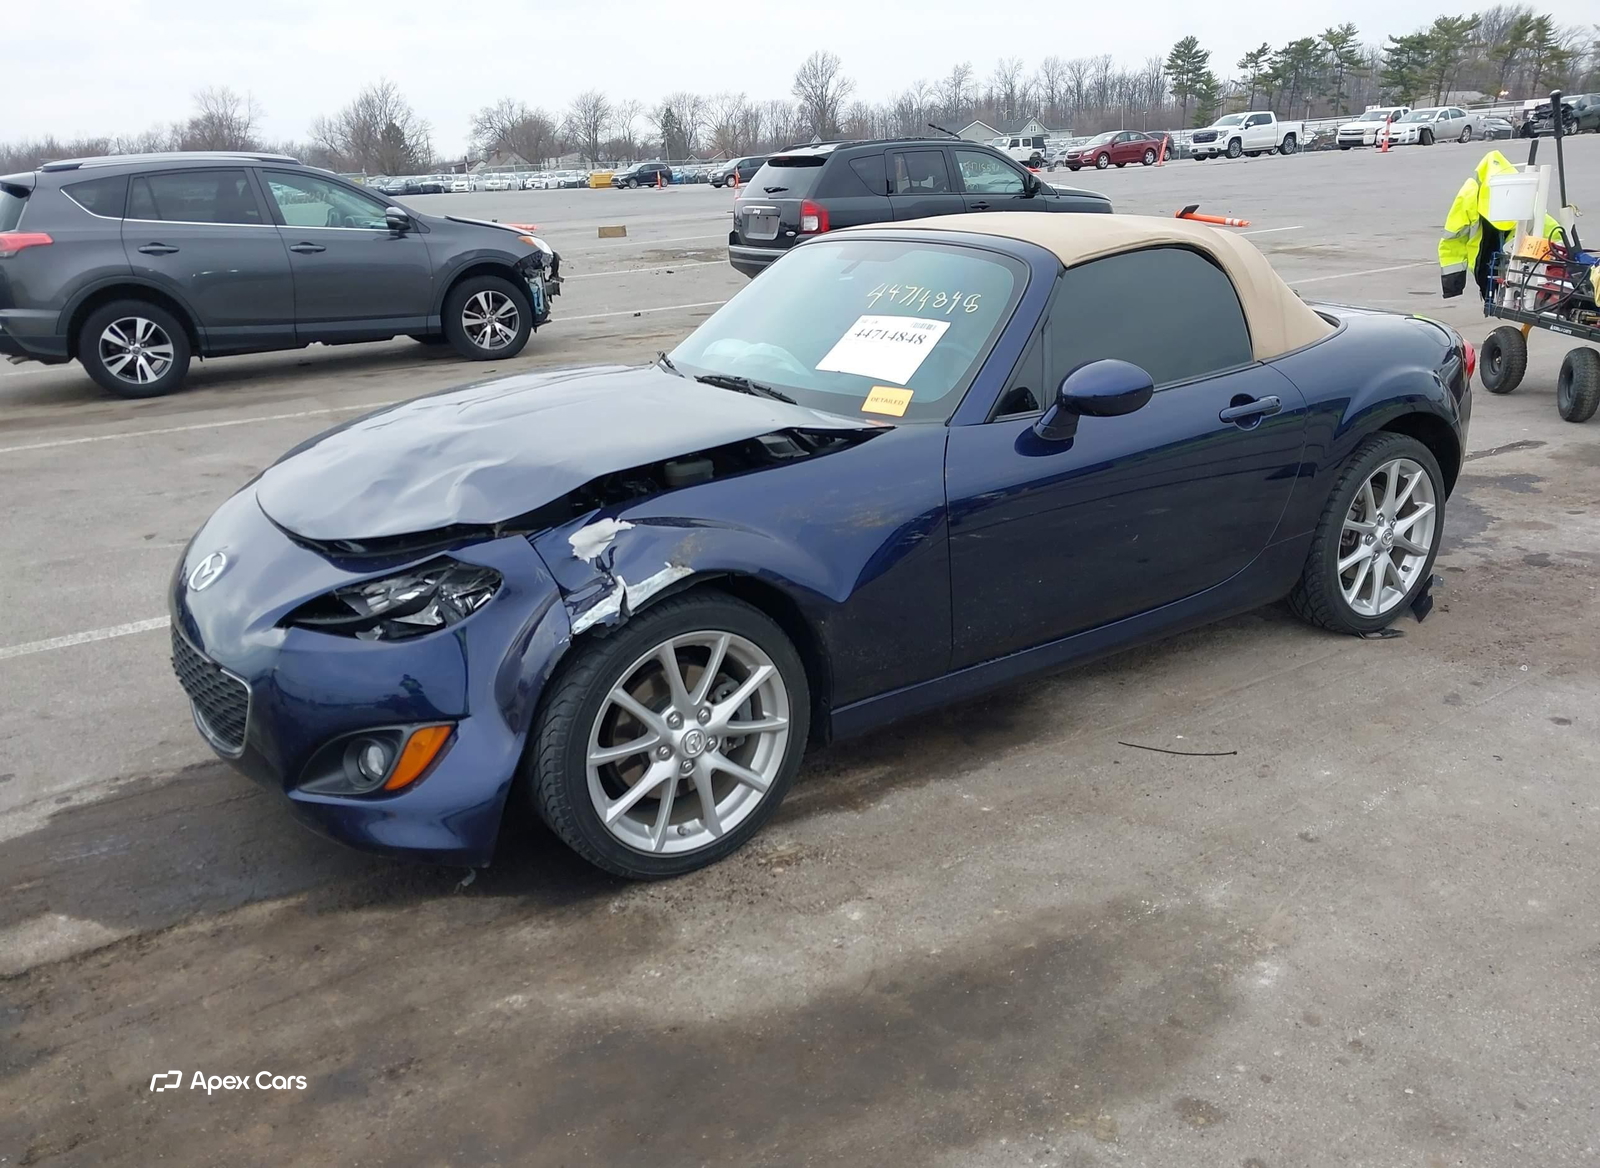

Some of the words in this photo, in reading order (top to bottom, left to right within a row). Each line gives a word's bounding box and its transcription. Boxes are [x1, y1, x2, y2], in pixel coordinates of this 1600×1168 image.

[866, 283, 982, 315] 44714848
[854, 328, 927, 345] 44714848
[870, 396, 904, 406] DETAILED
